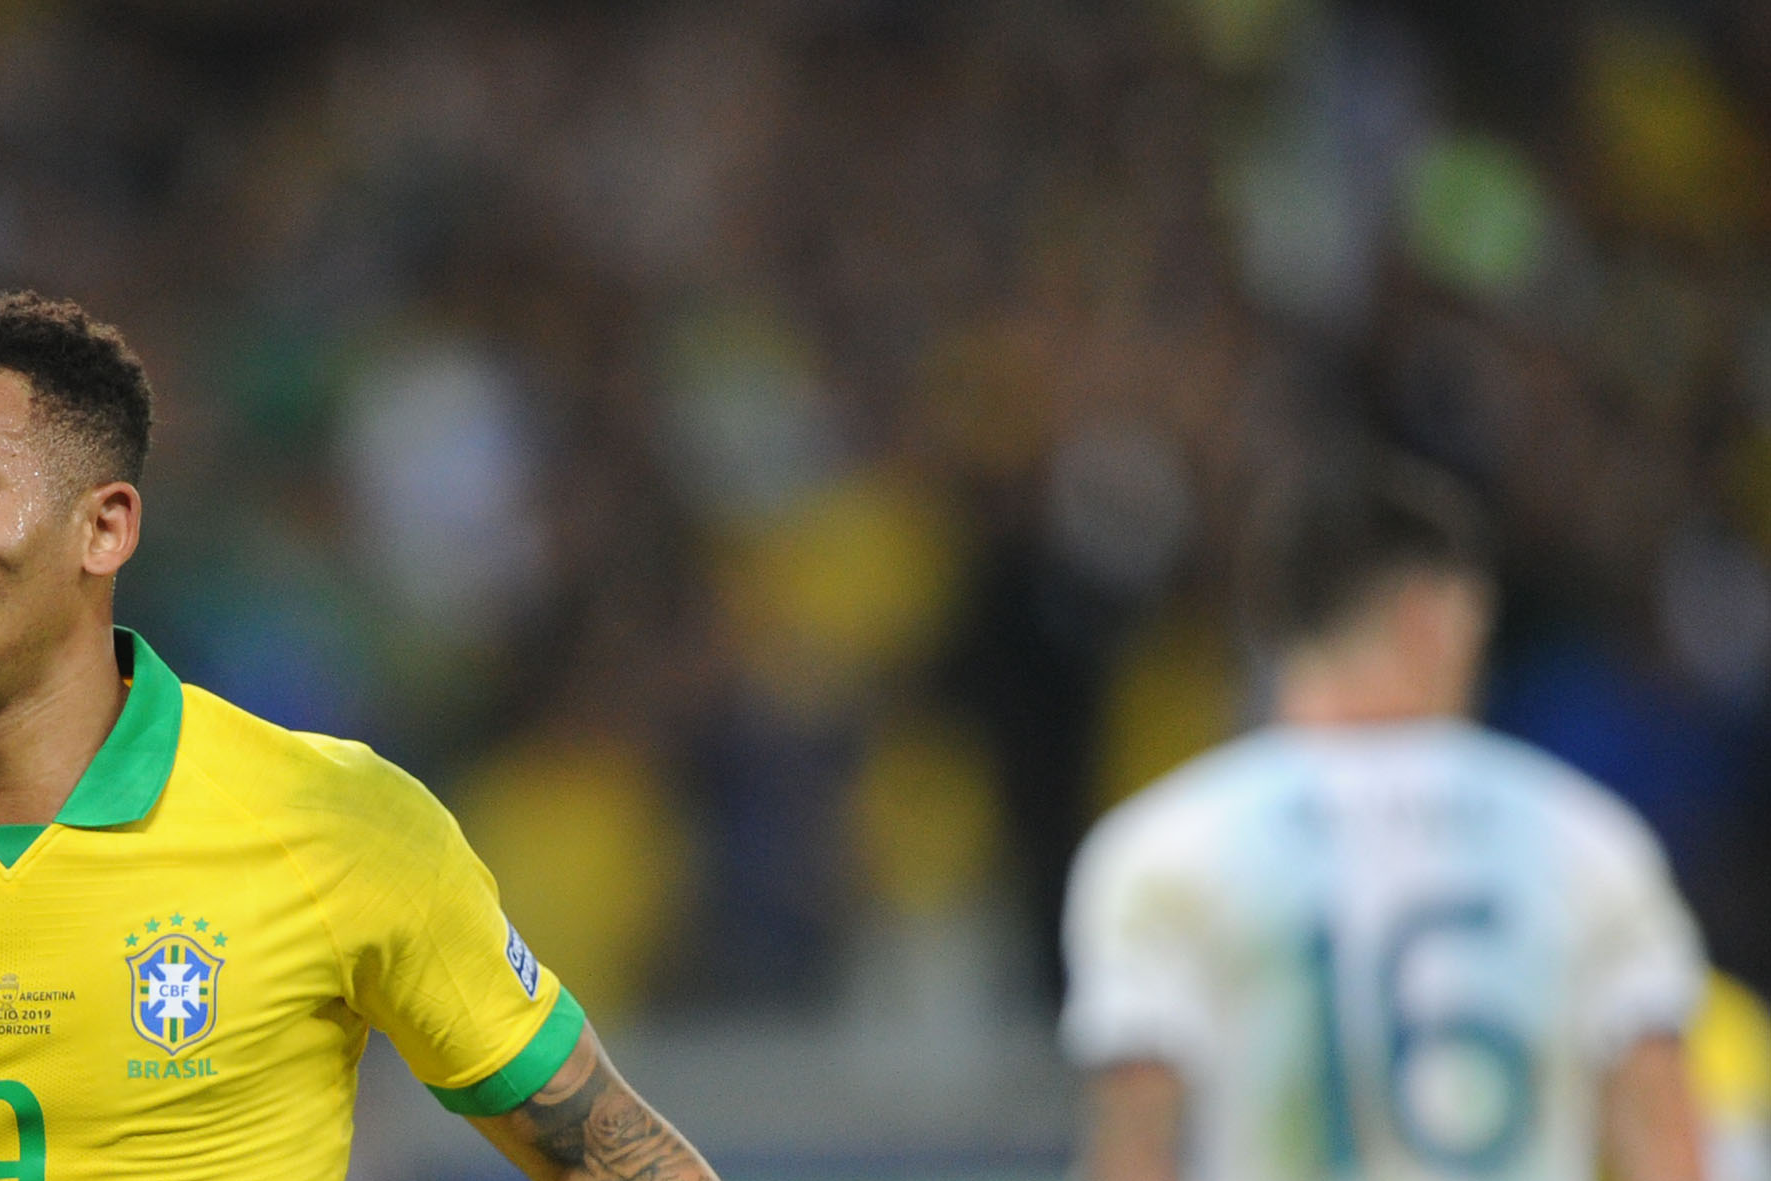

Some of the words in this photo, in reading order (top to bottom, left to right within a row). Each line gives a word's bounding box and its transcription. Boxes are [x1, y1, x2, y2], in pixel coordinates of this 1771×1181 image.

[19, 991, 76, 1001] ARGENTINA
[159, 984, 189, 997] CBF
[21, 1010, 52, 1020] 2019
[1294, 890, 1538, 1181] 16
[127, 1057, 218, 1079] BRASIL
